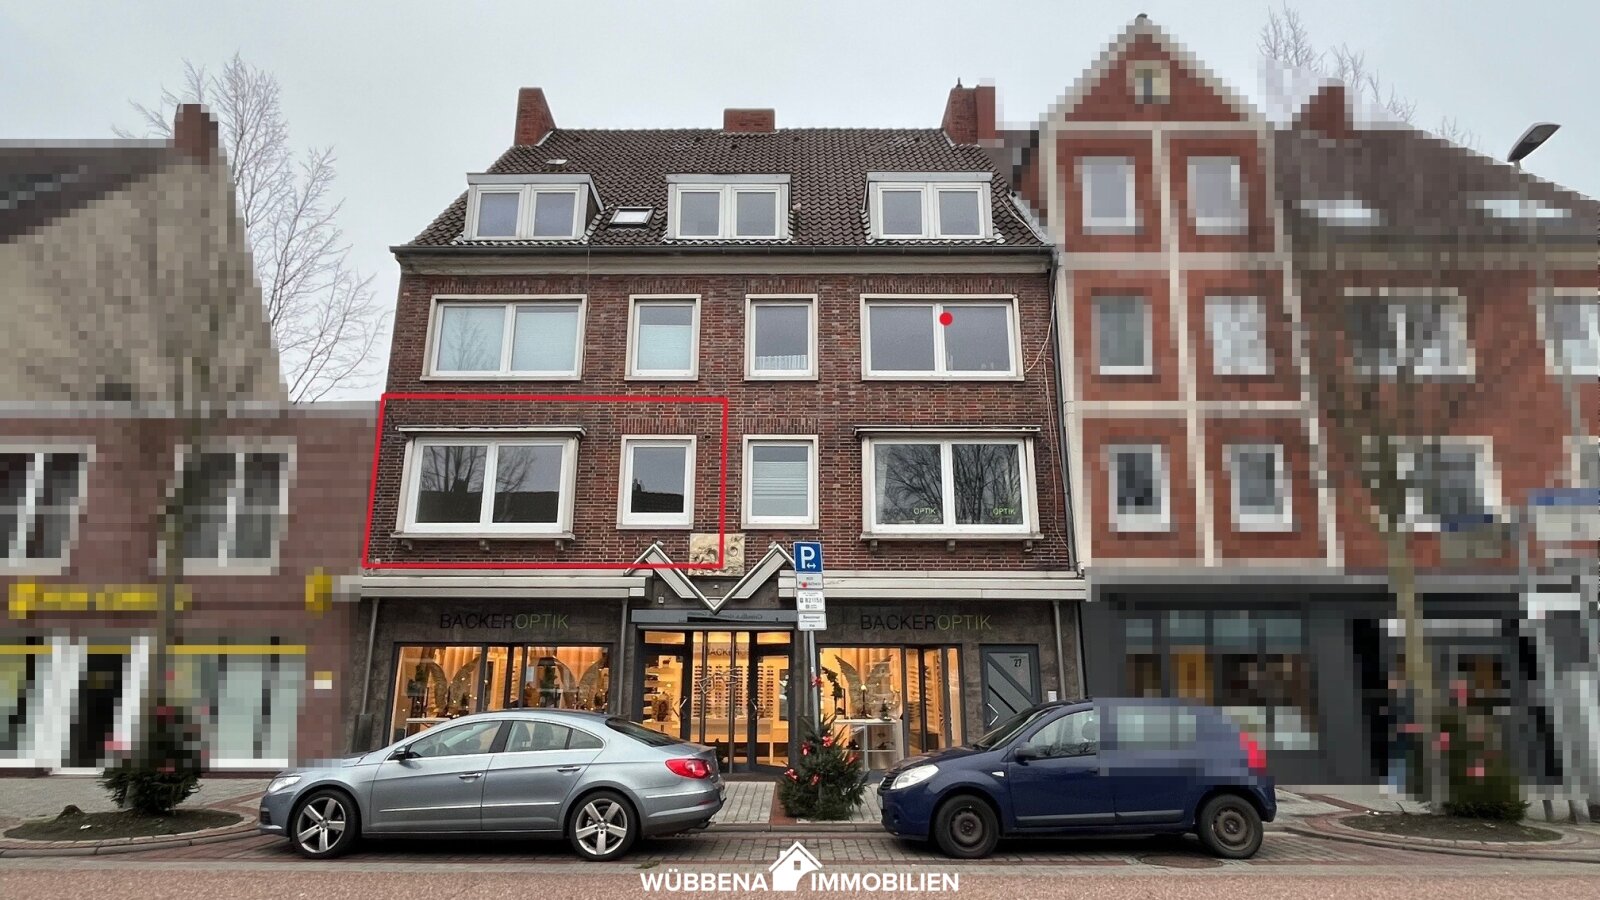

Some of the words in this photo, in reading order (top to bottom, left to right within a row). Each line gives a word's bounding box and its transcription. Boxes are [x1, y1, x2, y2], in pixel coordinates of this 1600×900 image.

[913, 507, 936, 515] OPTIK
[992, 507, 1016, 515] OPTIK
[800, 546, 815, 569] P
[440, 613, 569, 629] BACKEROPTIK
[860, 614, 992, 631] BACKEROPTIK
[1013, 658, 1022, 667] 27
